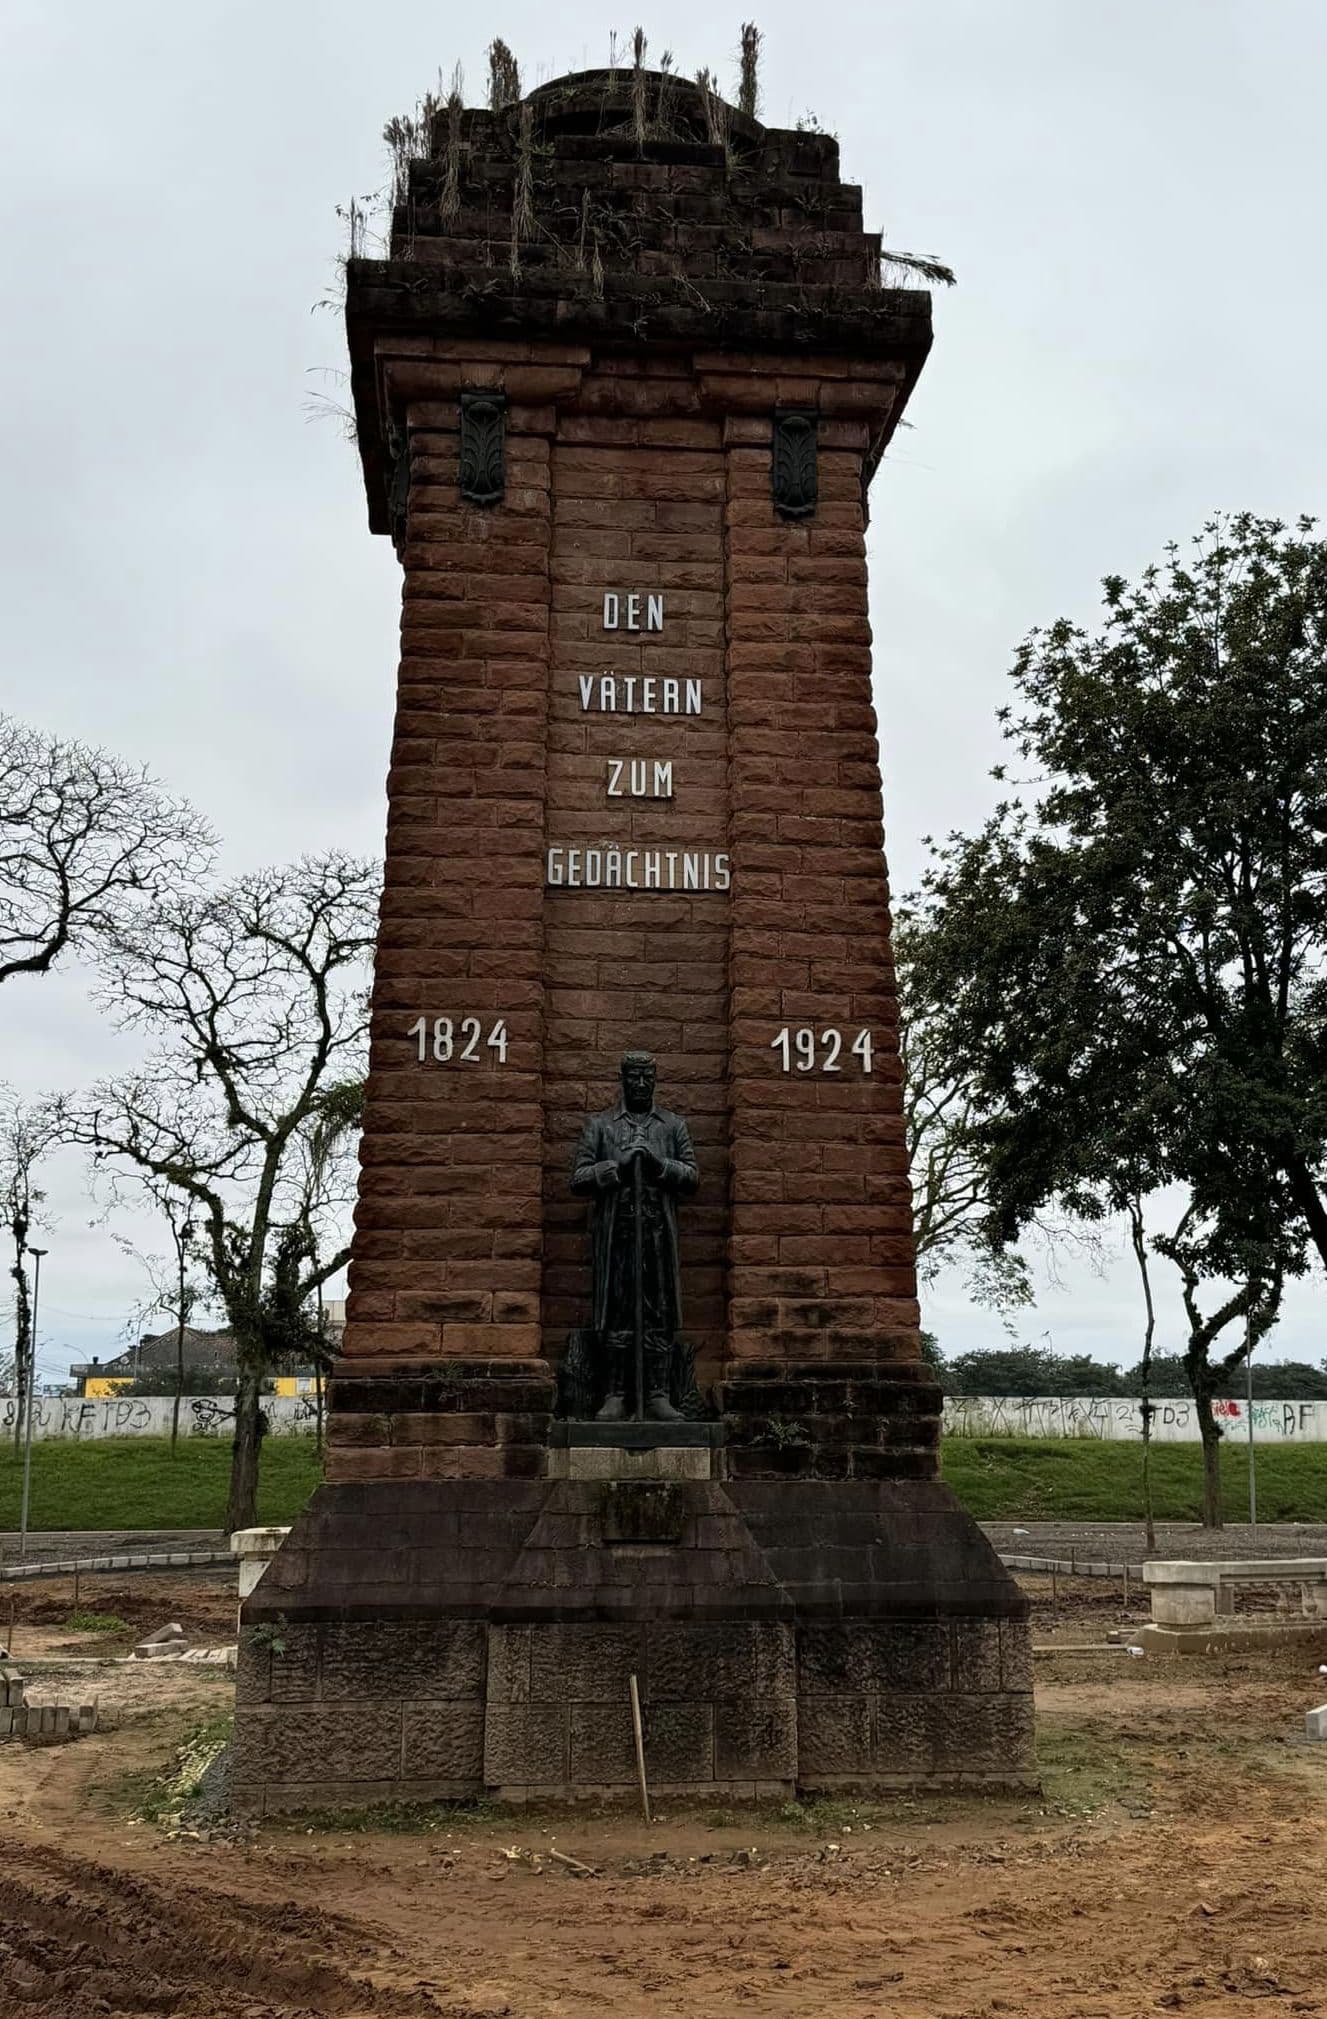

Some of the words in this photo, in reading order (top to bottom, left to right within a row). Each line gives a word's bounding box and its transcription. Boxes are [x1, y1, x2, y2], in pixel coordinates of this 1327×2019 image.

[603, 593, 664, 631] DEN
[578, 671, 702, 714] VÄTERN
[607, 759, 673, 798] ZUM
[547, 842, 731, 890] GEDÄCHTNIS
[407, 1016, 509, 1063] 1824
[771, 1027, 875, 1073] 1924
